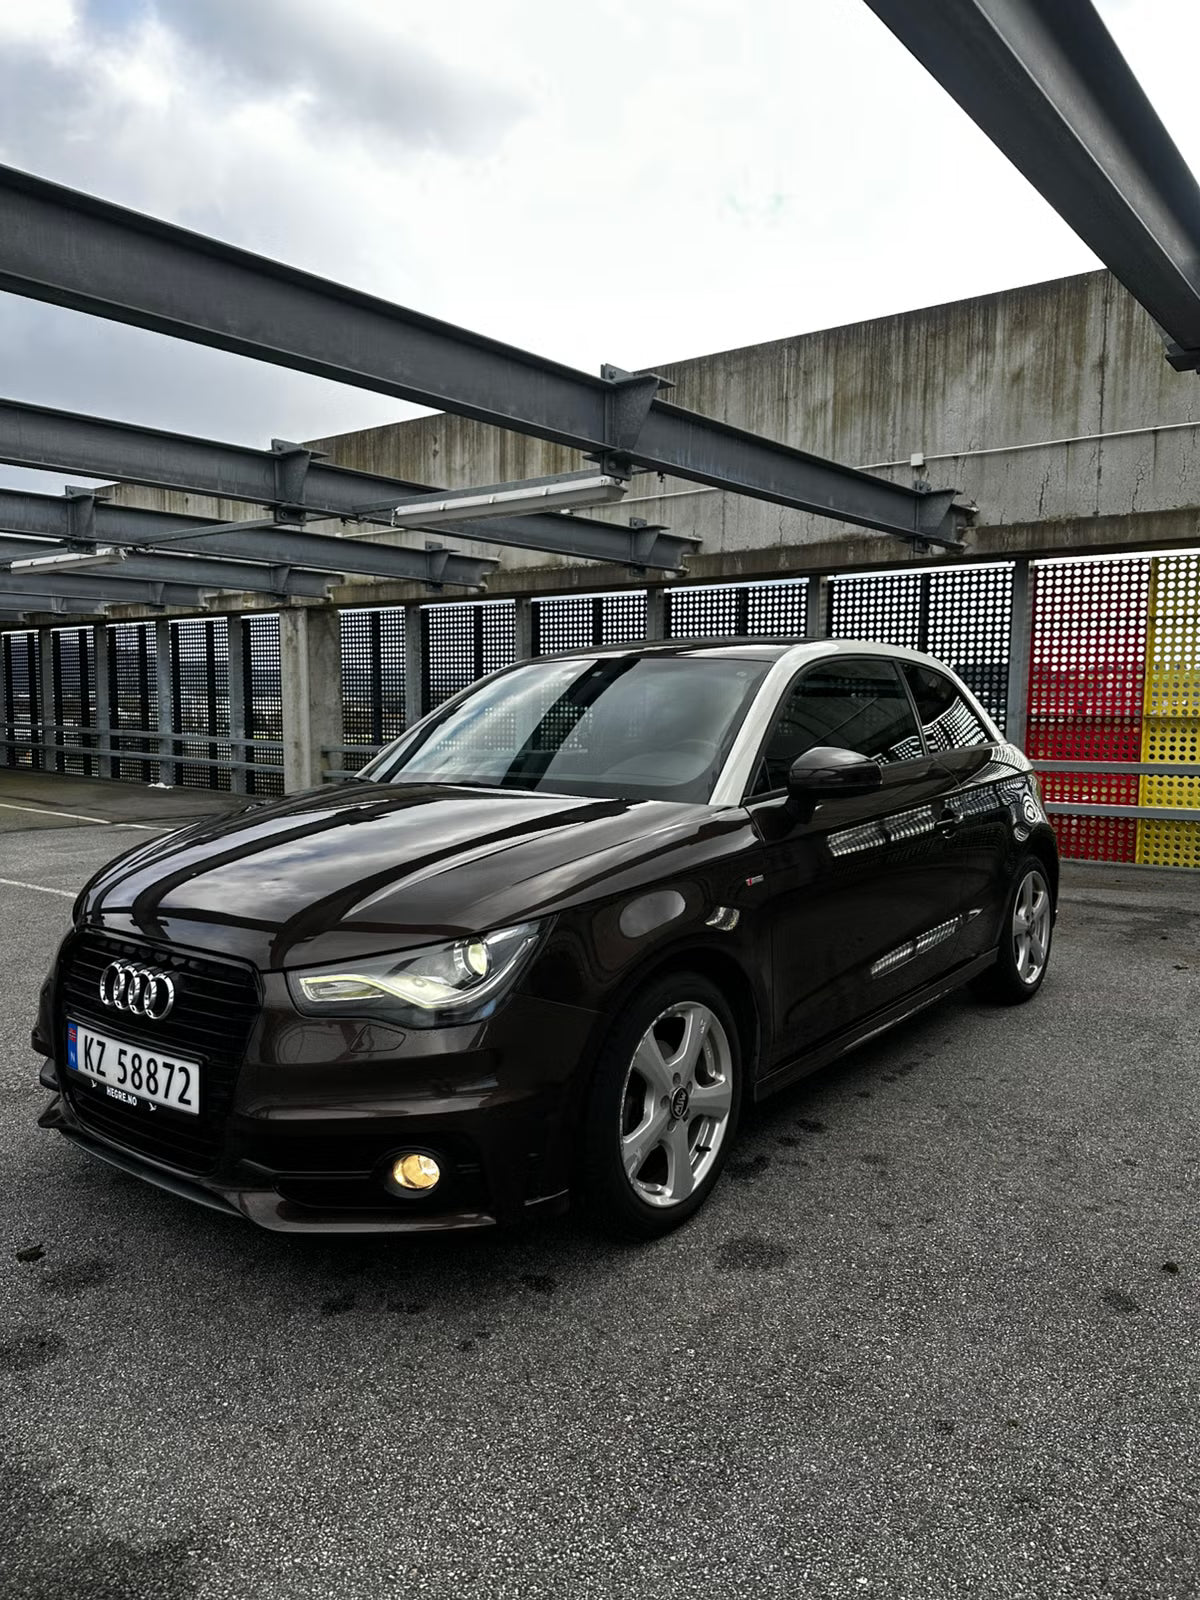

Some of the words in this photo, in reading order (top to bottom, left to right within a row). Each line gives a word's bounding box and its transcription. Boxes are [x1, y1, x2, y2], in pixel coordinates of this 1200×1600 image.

[70, 1051, 76, 1063] N
[84, 1035, 106, 1077] KZ
[117, 1048, 191, 1105] 58872
[106, 1086, 138, 1106] HEGRE.NO
